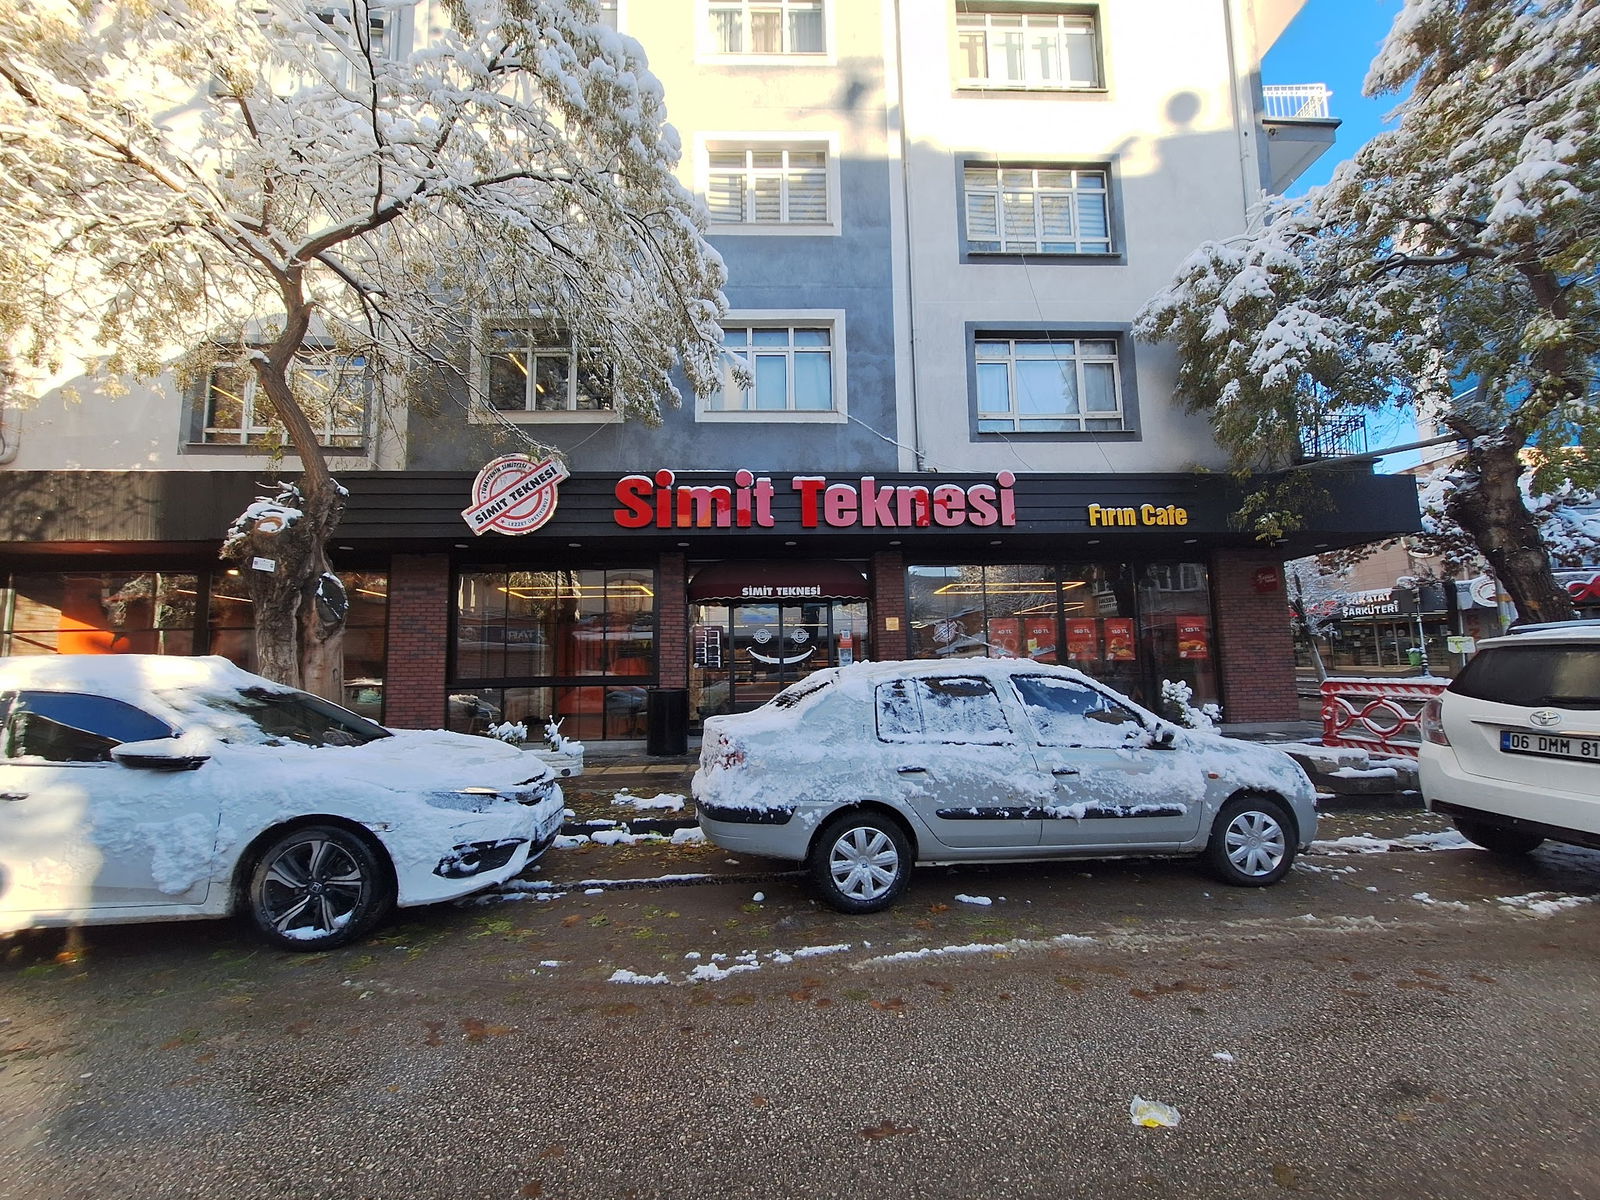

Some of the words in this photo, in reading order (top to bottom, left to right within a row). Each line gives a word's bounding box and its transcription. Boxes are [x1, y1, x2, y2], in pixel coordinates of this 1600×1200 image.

[475, 498, 508, 525] SİMİT
[509, 464, 558, 502] TEKNESİ
[613, 469, 775, 528] Simit
[792, 470, 1016, 527] Teknesi
[1140, 504, 1188, 526] Cafe
[742, 585, 773, 596] SİMİT
[776, 585, 820, 596] TEKNESİ
[1342, 600, 1399, 618] ŞARKÜTERİ
[1511, 734, 1529, 749] 06
[1539, 736, 1570, 754] DMM
[1581, 741, 1599, 757] 81
